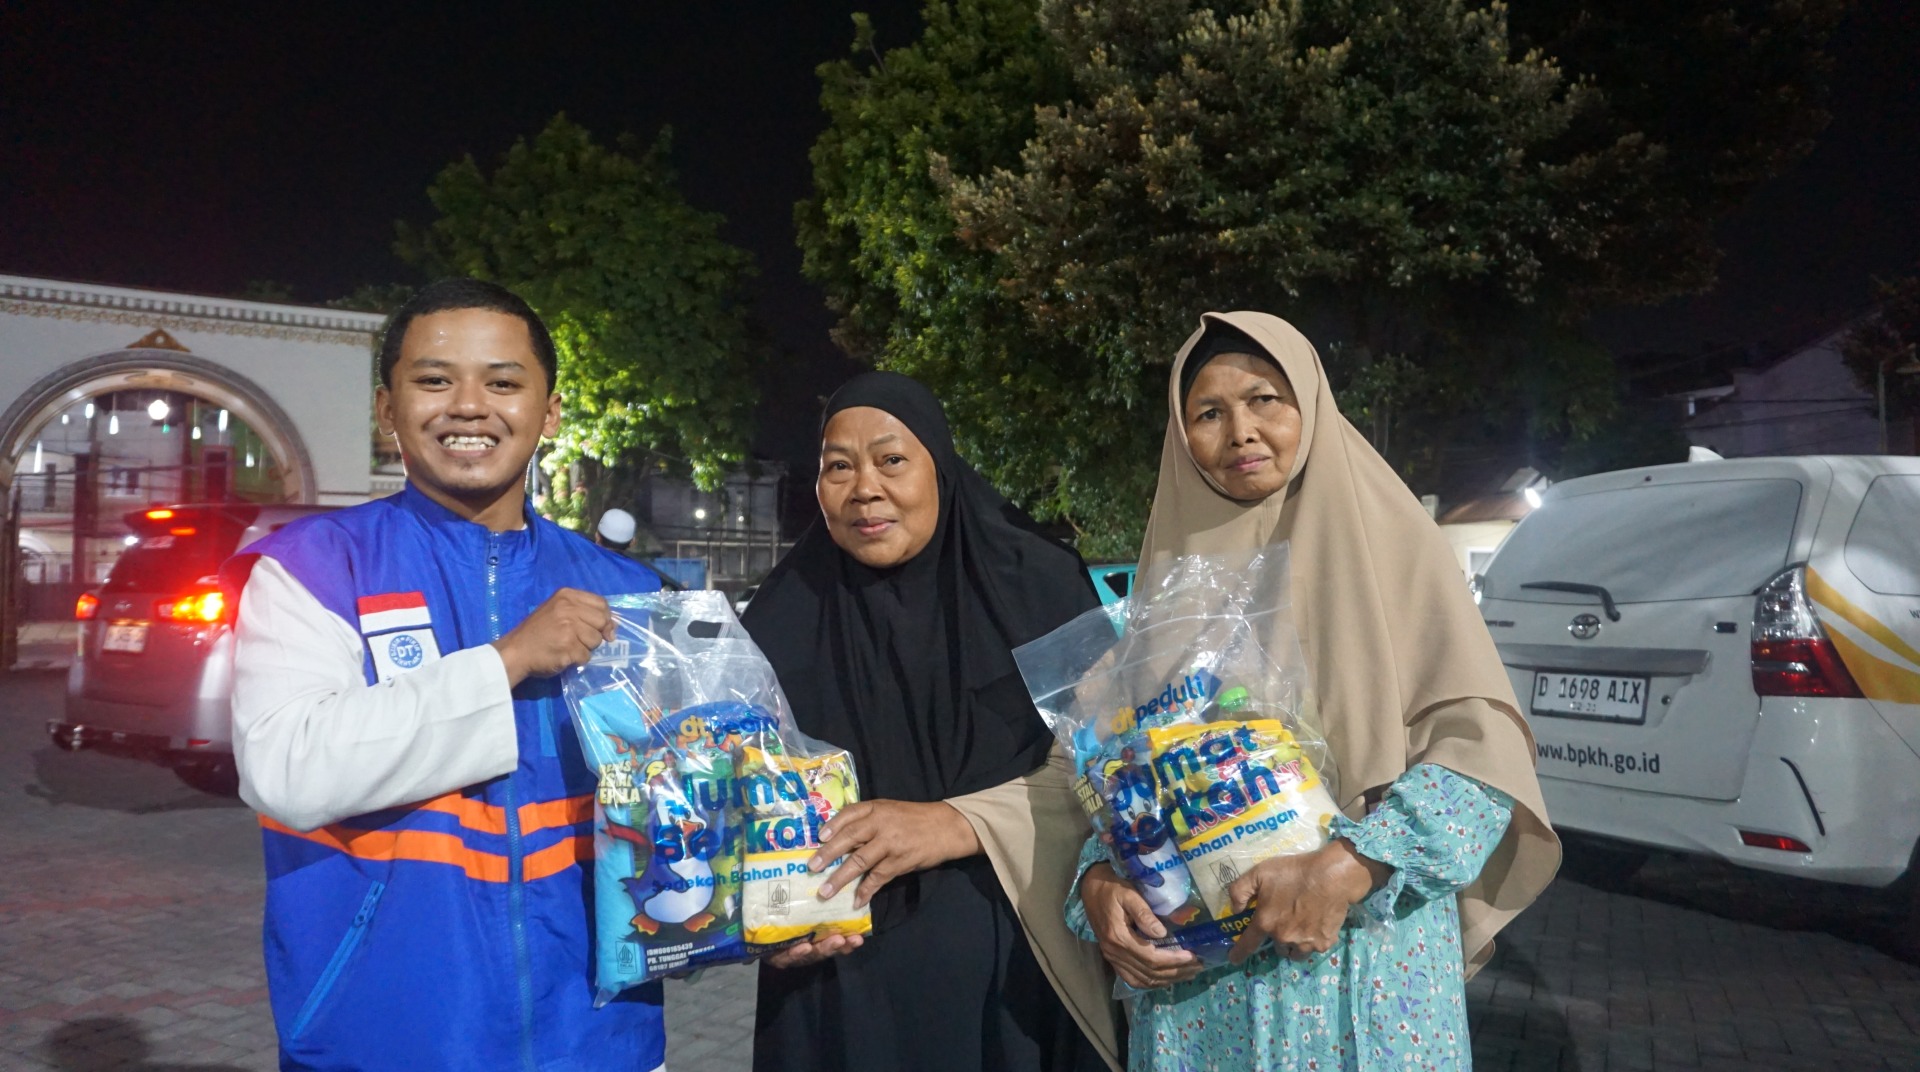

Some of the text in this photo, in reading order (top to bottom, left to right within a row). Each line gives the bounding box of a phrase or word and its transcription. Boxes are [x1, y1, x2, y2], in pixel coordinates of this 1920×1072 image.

[397, 645, 413, 658] DT
[1538, 676, 1642, 704] D 1698 AIX
[1184, 833, 1233, 862] Bahan
[1233, 808, 1299, 840] Pangan
[730, 867, 783, 882] Bahan
